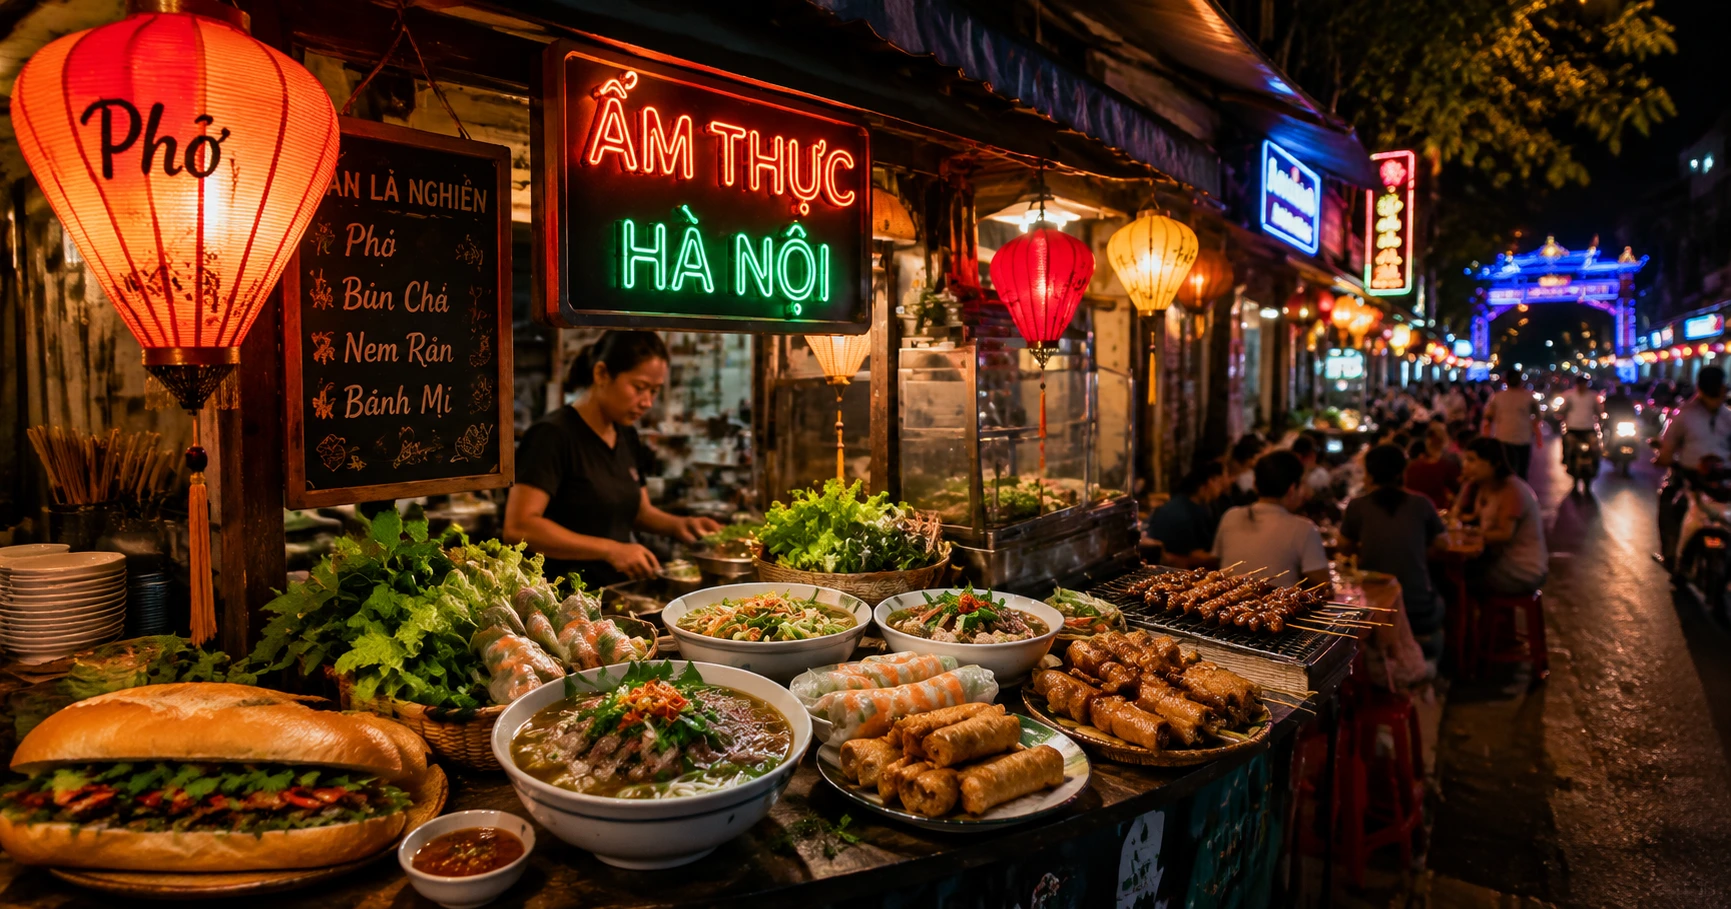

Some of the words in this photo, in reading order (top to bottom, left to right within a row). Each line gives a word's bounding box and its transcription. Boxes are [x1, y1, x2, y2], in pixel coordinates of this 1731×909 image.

[80, 97, 231, 180] Phở
[589, 71, 694, 179] ẨM
[710, 120, 855, 216] THỰC
[623, 204, 715, 294] HÀ
[736, 219, 830, 316] NỘI
[344, 331, 400, 364] Nem
